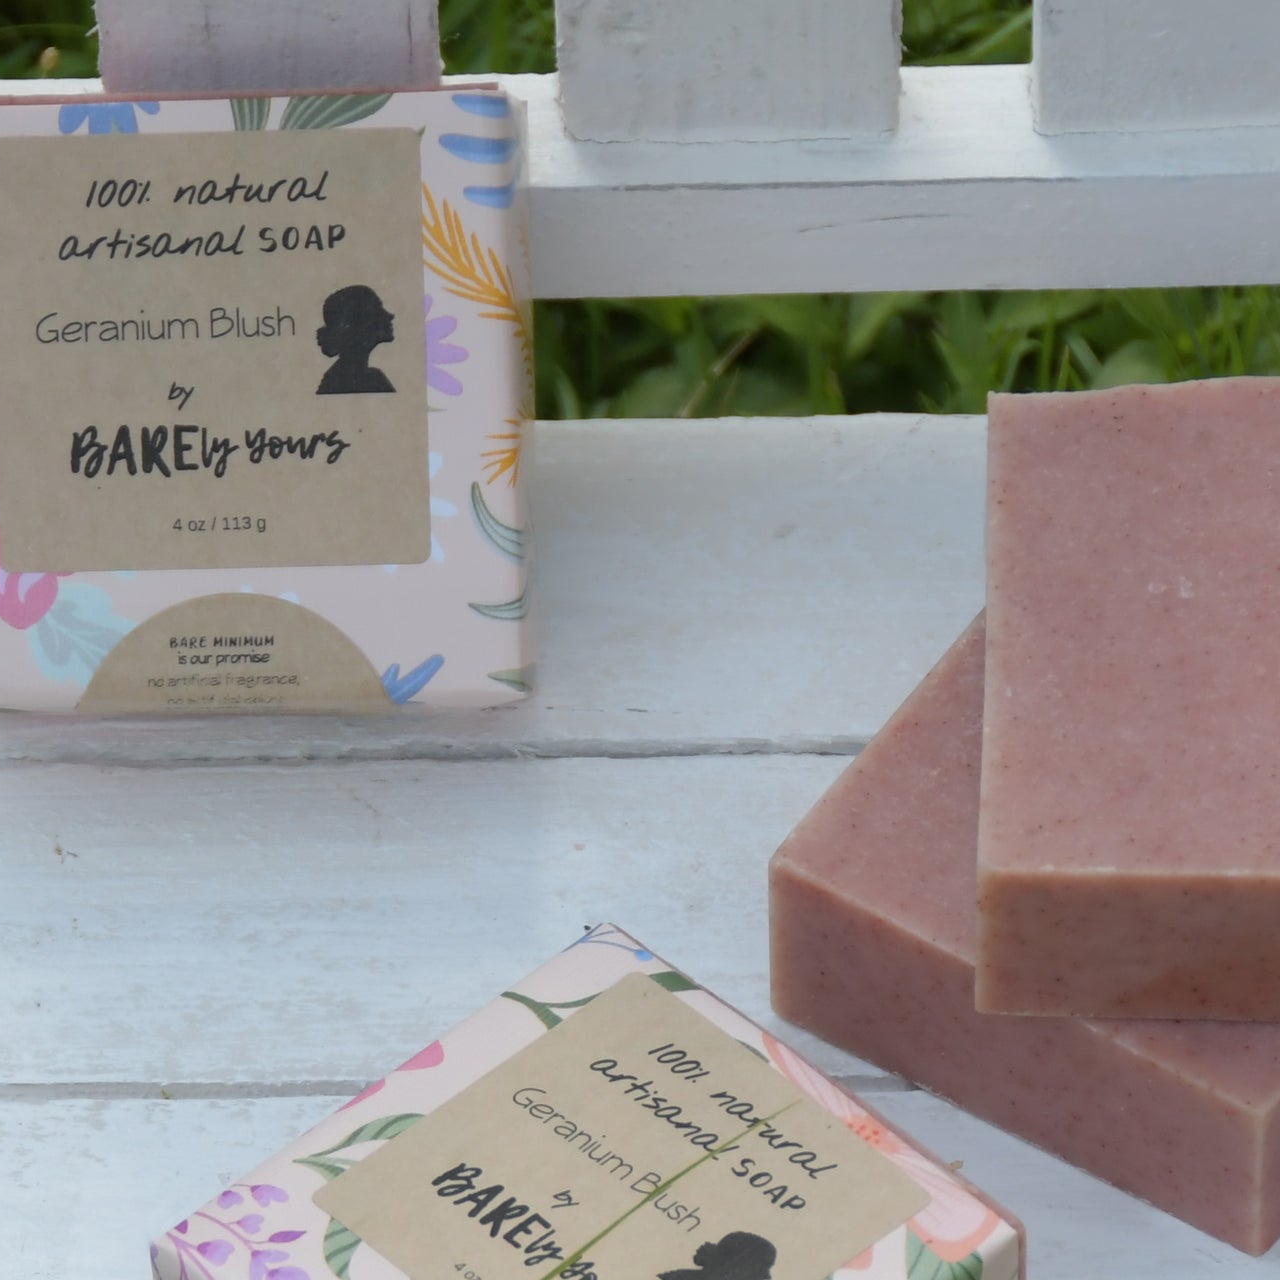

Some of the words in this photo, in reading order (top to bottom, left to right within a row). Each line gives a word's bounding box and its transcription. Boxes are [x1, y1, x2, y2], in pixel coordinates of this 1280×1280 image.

[85, 178, 151, 209] 100%
[172, 170, 329, 205] natural
[58, 224, 246, 261] artisanal
[258, 224, 346, 253] SOAP
[34, 306, 201, 345] Geranium
[209, 305, 296, 339] Blush
[167, 381, 195, 411] by
[172, 518, 183, 531] 4
[187, 519, 207, 532] oz
[210, 516, 217, 532] /
[222, 516, 252, 531] 113
[256, 518, 267, 534] g
[169, 635, 206, 649] BARE
[212, 635, 275, 648] MINIMUM
[177, 650, 188, 665] is
[189, 654, 213, 665] our
[215, 649, 271, 667] promise
[147, 678, 165, 688] no
[647, 1043, 710, 1084] 100%
[512, 1087, 634, 1181] Geranium
[589, 1058, 740, 1161] artisanal
[731, 1158, 806, 1210] SOAP
[551, 1189, 580, 1209] by
[454, 1263, 467, 1272] 4
